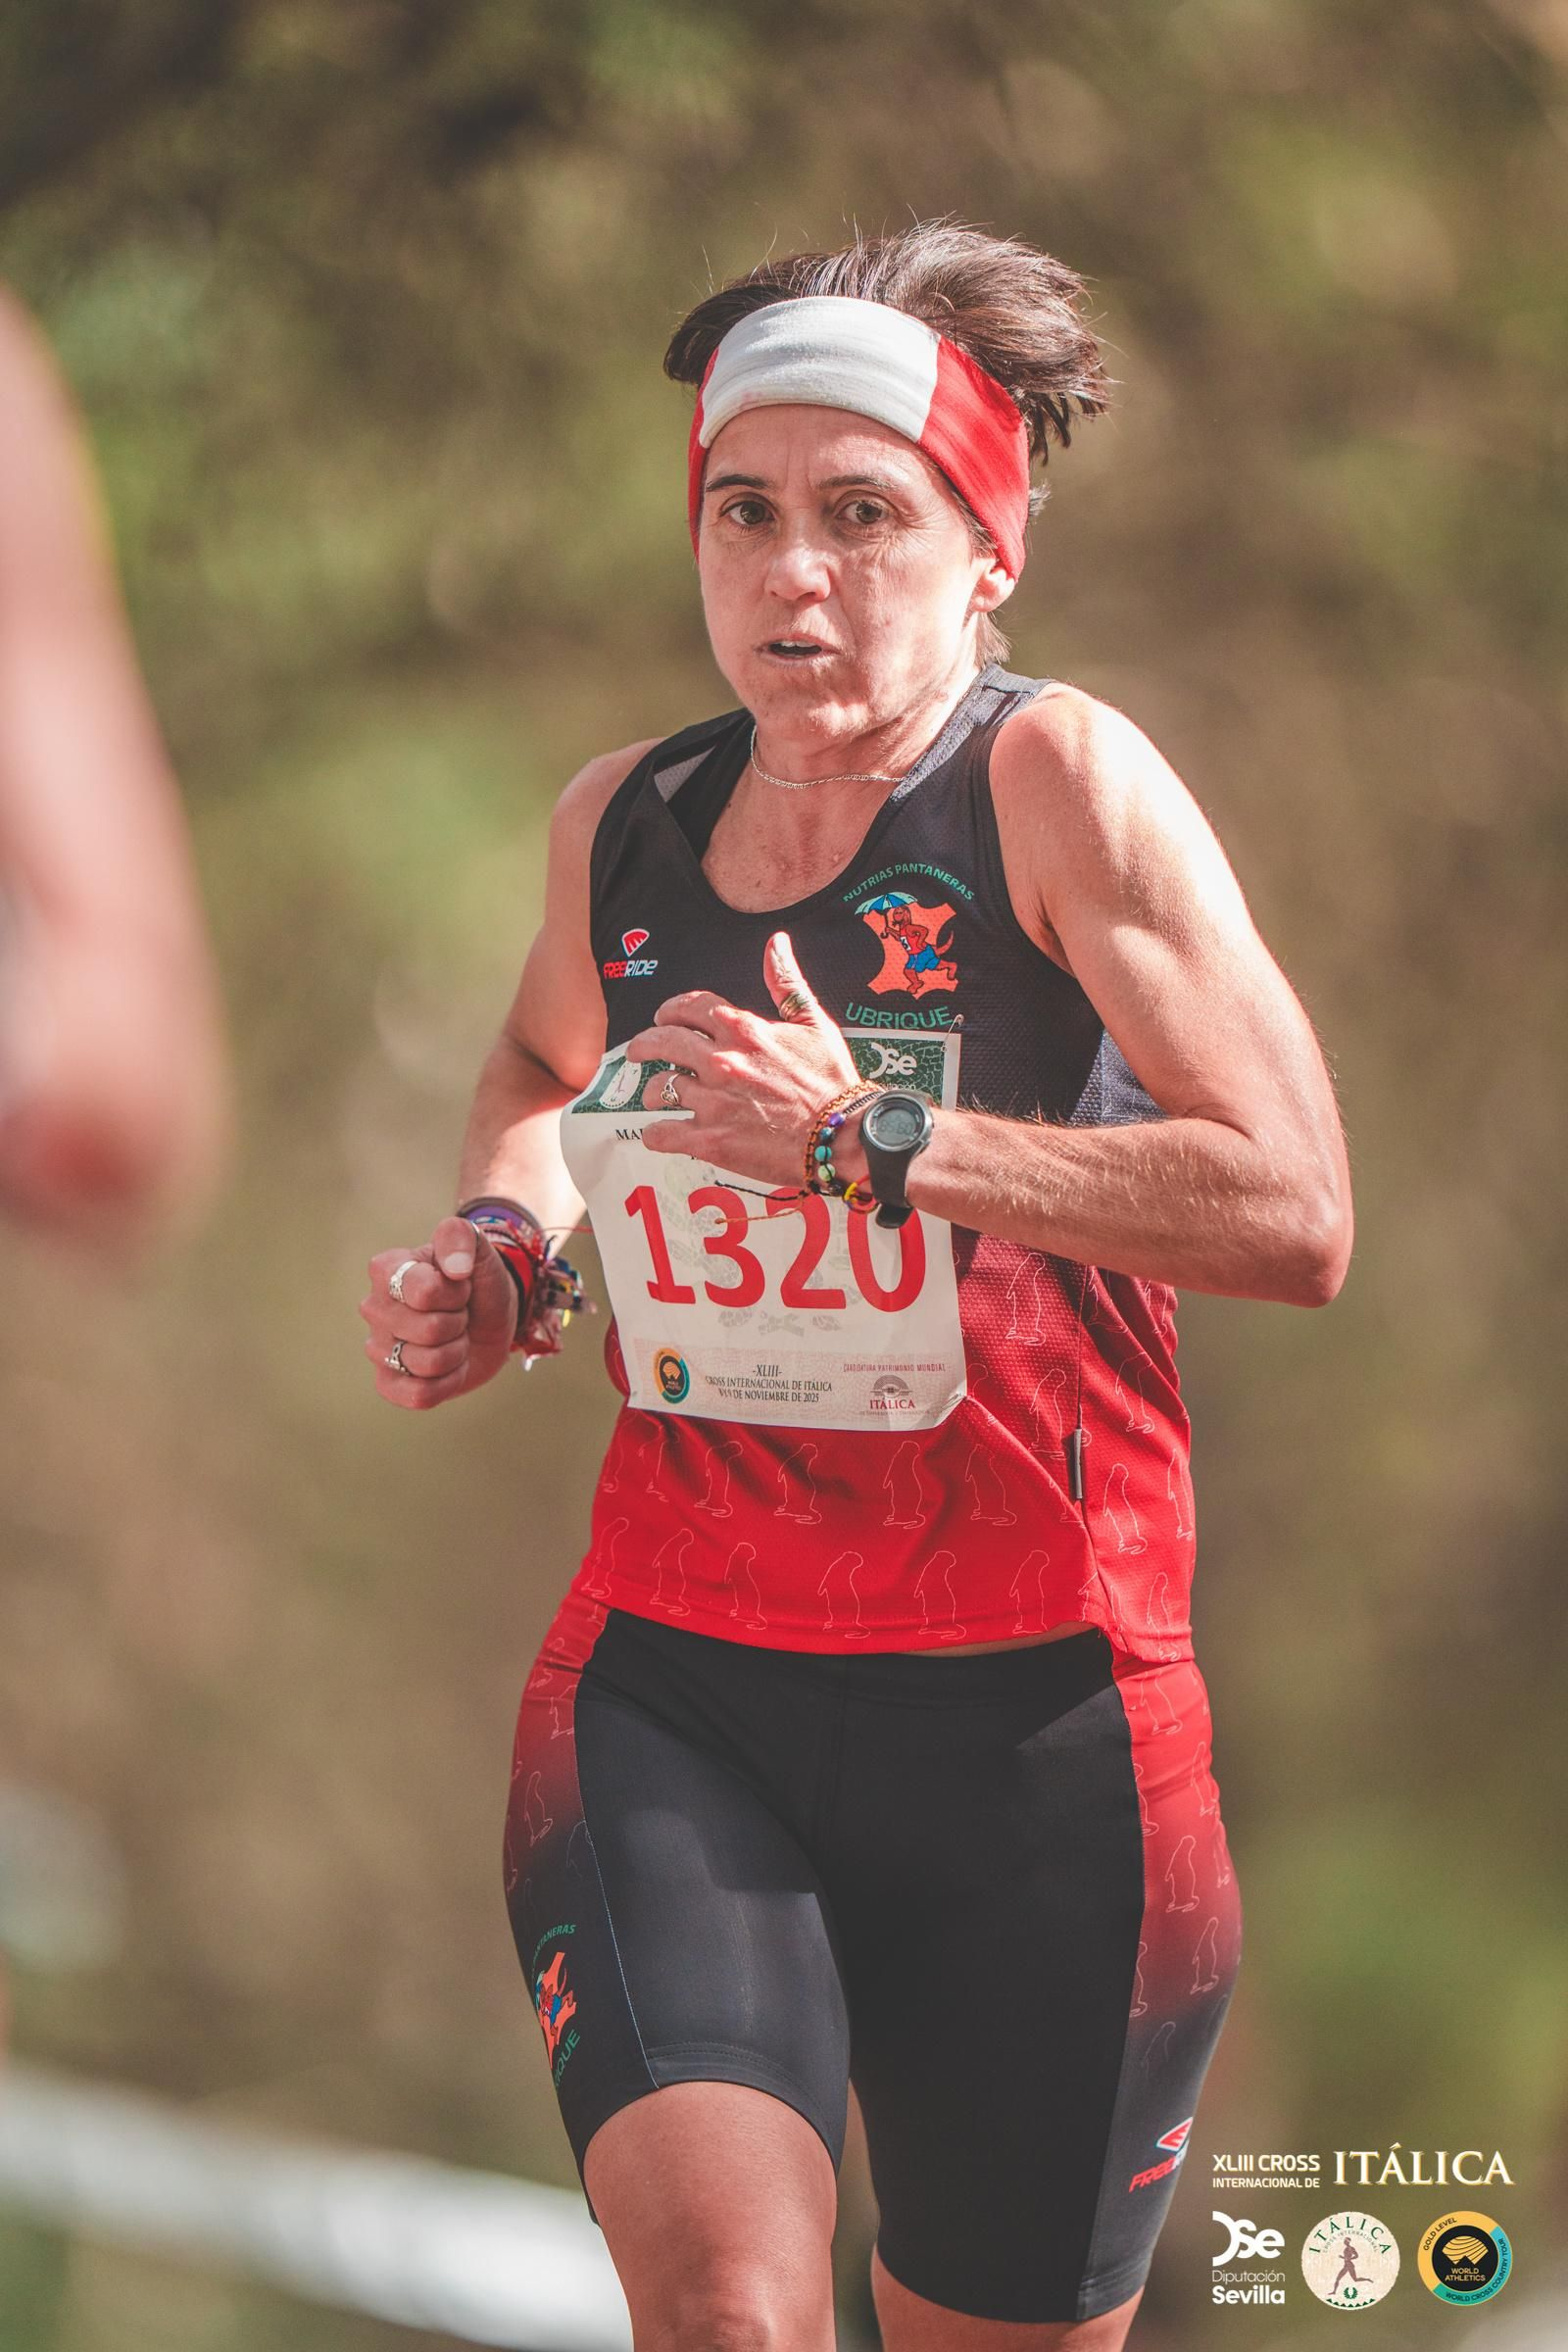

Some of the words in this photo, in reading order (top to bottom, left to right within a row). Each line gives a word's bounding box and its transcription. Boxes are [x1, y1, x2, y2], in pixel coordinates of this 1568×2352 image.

[843, 866, 894, 902] NUTRIAS
[895, 862, 975, 901] PANTANERAS
[845, 1003, 954, 1029] UBRIQUE
[623, 1185, 927, 1313] 1320
[878, 1363, 914, 1372] PATRIMONIO
[916, 1363, 947, 1372] MUNDIAL
[705, 1375, 726, 1387] CROSS
[727, 1378, 790, 1390] INTERNACIONAL
[792, 1381, 803, 1391] DE
[804, 1379, 833, 1392] ITÁLICA
[733, 1389, 743, 1399] DE
[745, 1390, 790, 1401] NOVIEMBRE
[791, 1393, 802, 1402] DE
[803, 1393, 820, 1403] 2025
